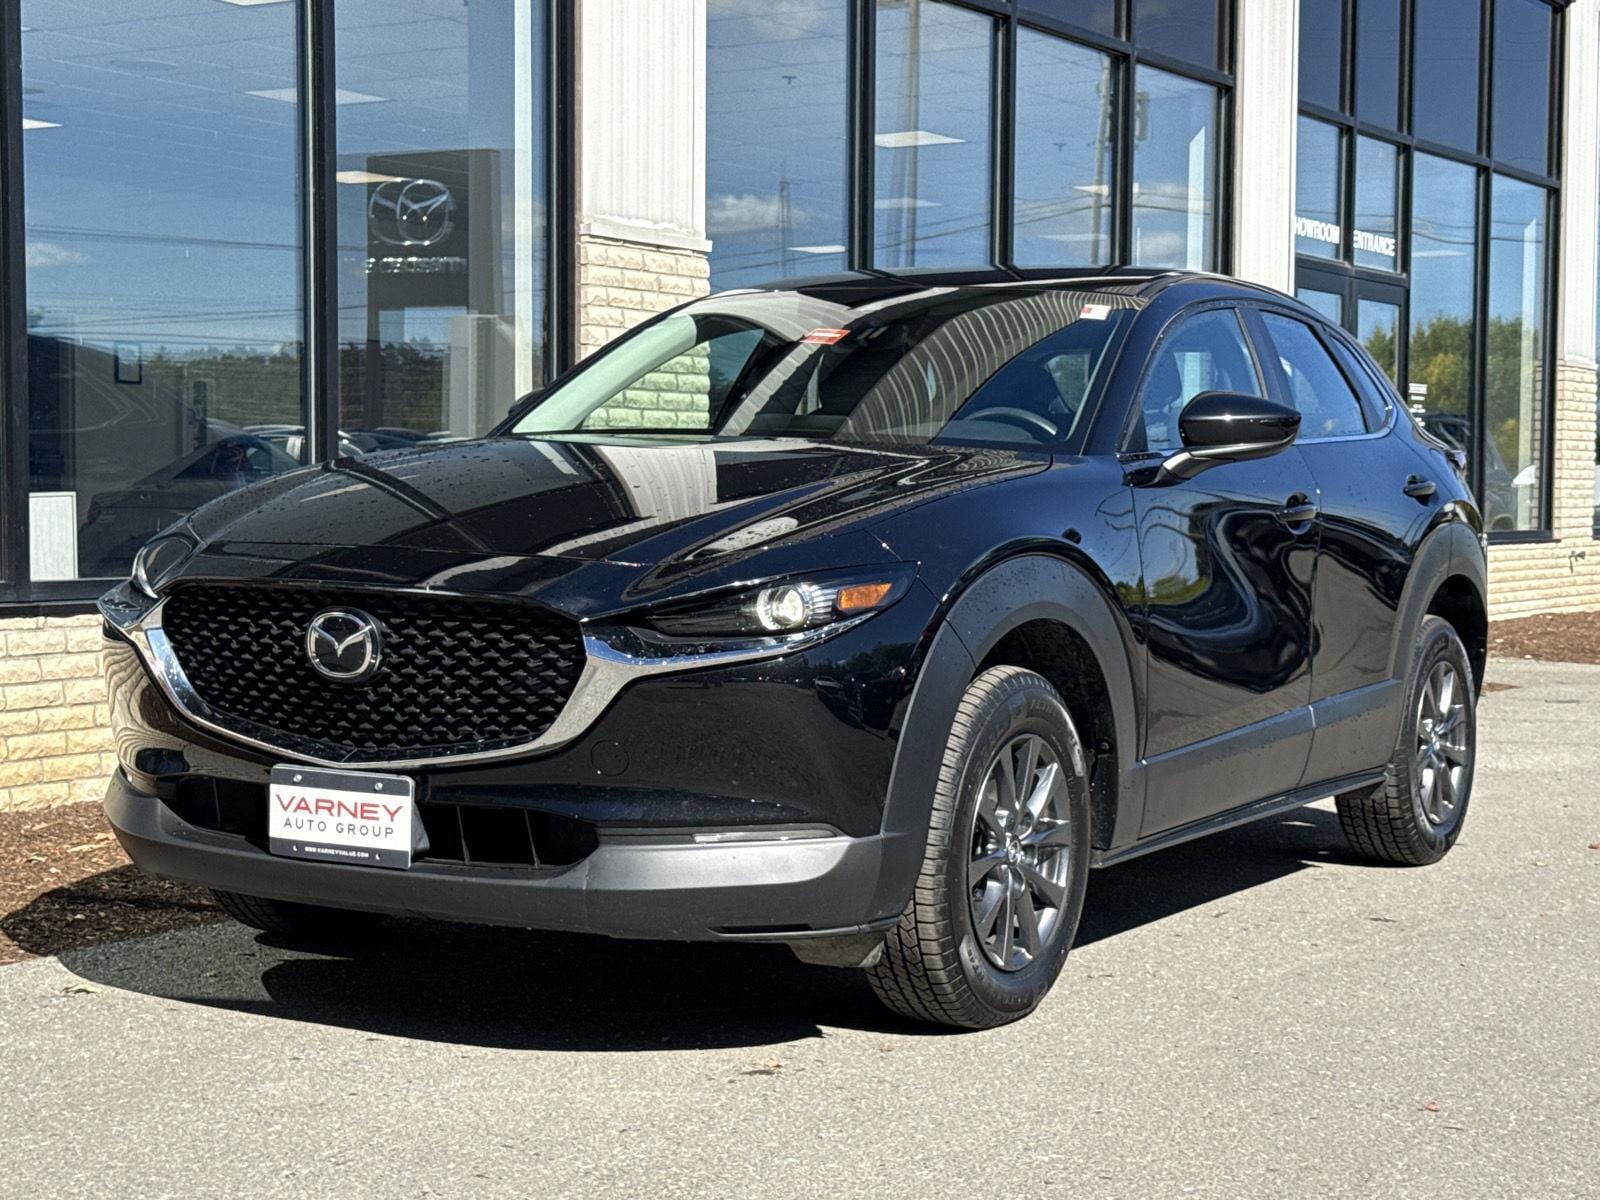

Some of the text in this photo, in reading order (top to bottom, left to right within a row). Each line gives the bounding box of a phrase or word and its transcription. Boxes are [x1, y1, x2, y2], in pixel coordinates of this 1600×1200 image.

[1293, 216, 1396, 257] HOWROOM ENTRANCE
[276, 794, 403, 822] VARNEY
[284, 817, 394, 838] AUTO GROUP
